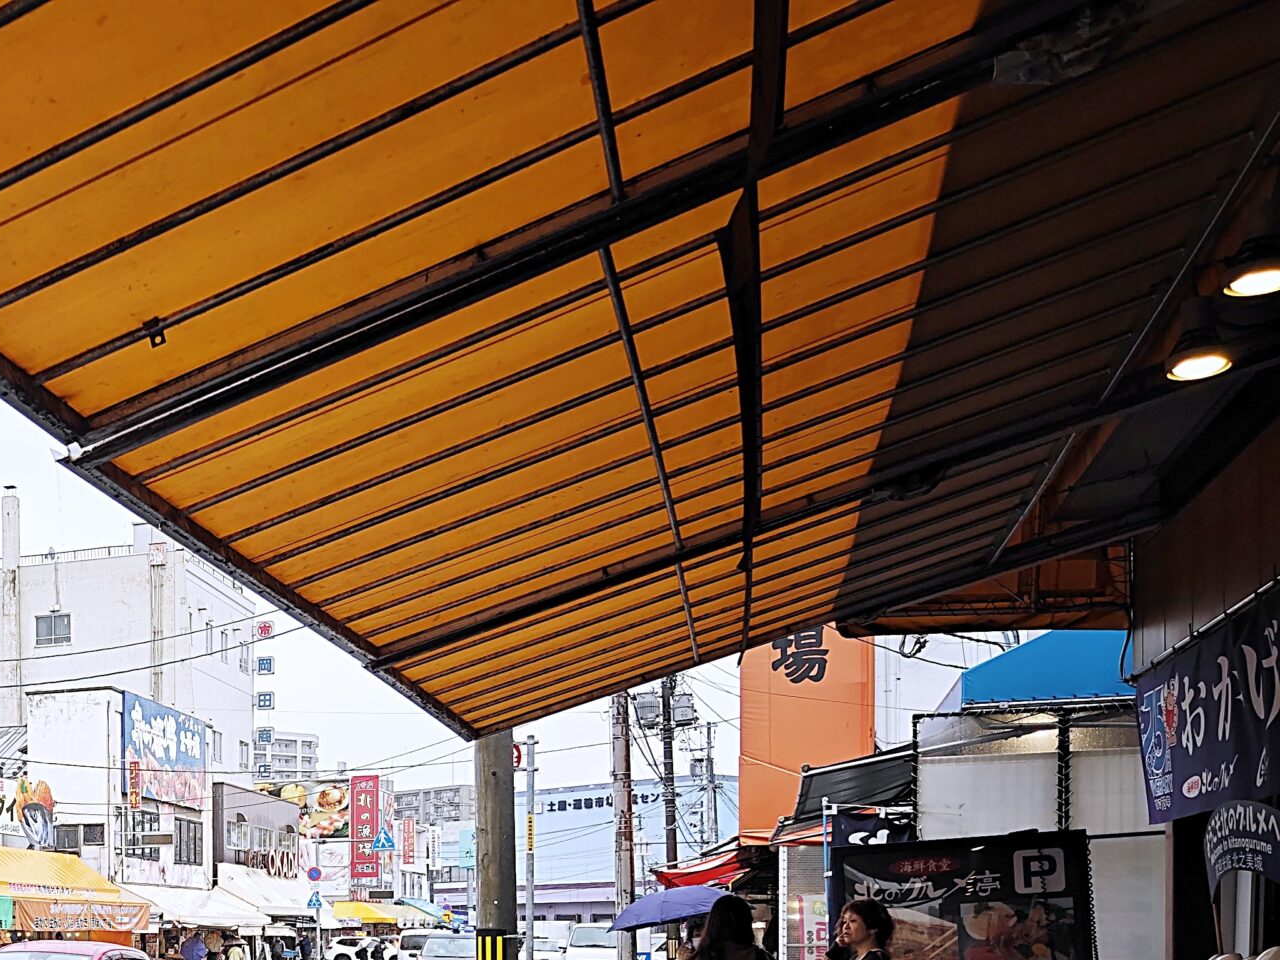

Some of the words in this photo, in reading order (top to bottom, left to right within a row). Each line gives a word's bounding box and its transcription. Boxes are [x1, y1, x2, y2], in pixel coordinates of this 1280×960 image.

[258, 658, 272, 778] 岡田商店
[1228, 836, 1272, 854] kitanogurume
[900, 859, 952, 873] 海鮮食堂
